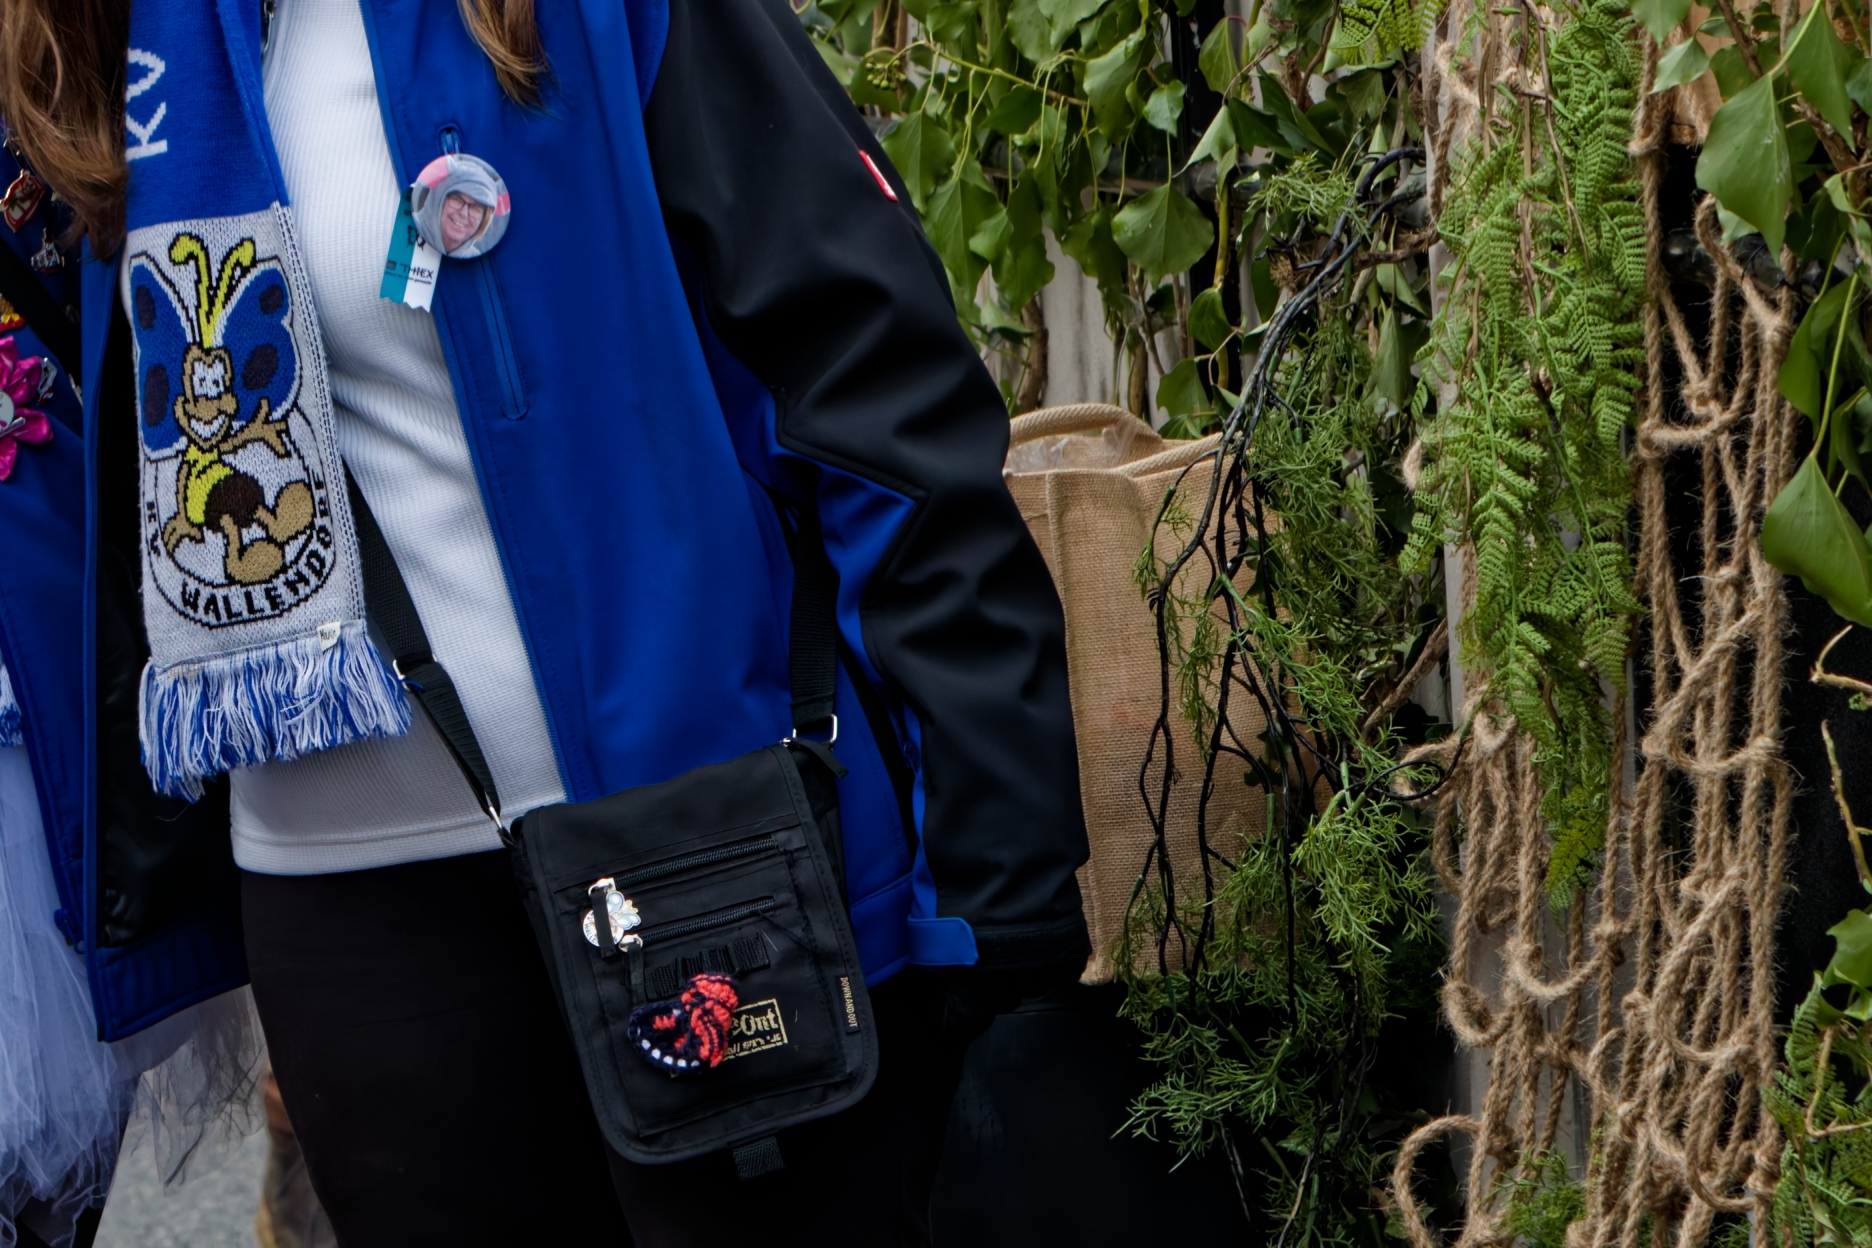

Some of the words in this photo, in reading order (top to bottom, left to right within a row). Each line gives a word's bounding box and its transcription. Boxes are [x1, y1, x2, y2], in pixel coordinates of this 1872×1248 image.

[181, 467, 333, 623] WALLENDORF
[840, 976, 852, 998] DOWN
[844, 998, 855, 1014] AND
[847, 1013, 858, 1027] OUT
